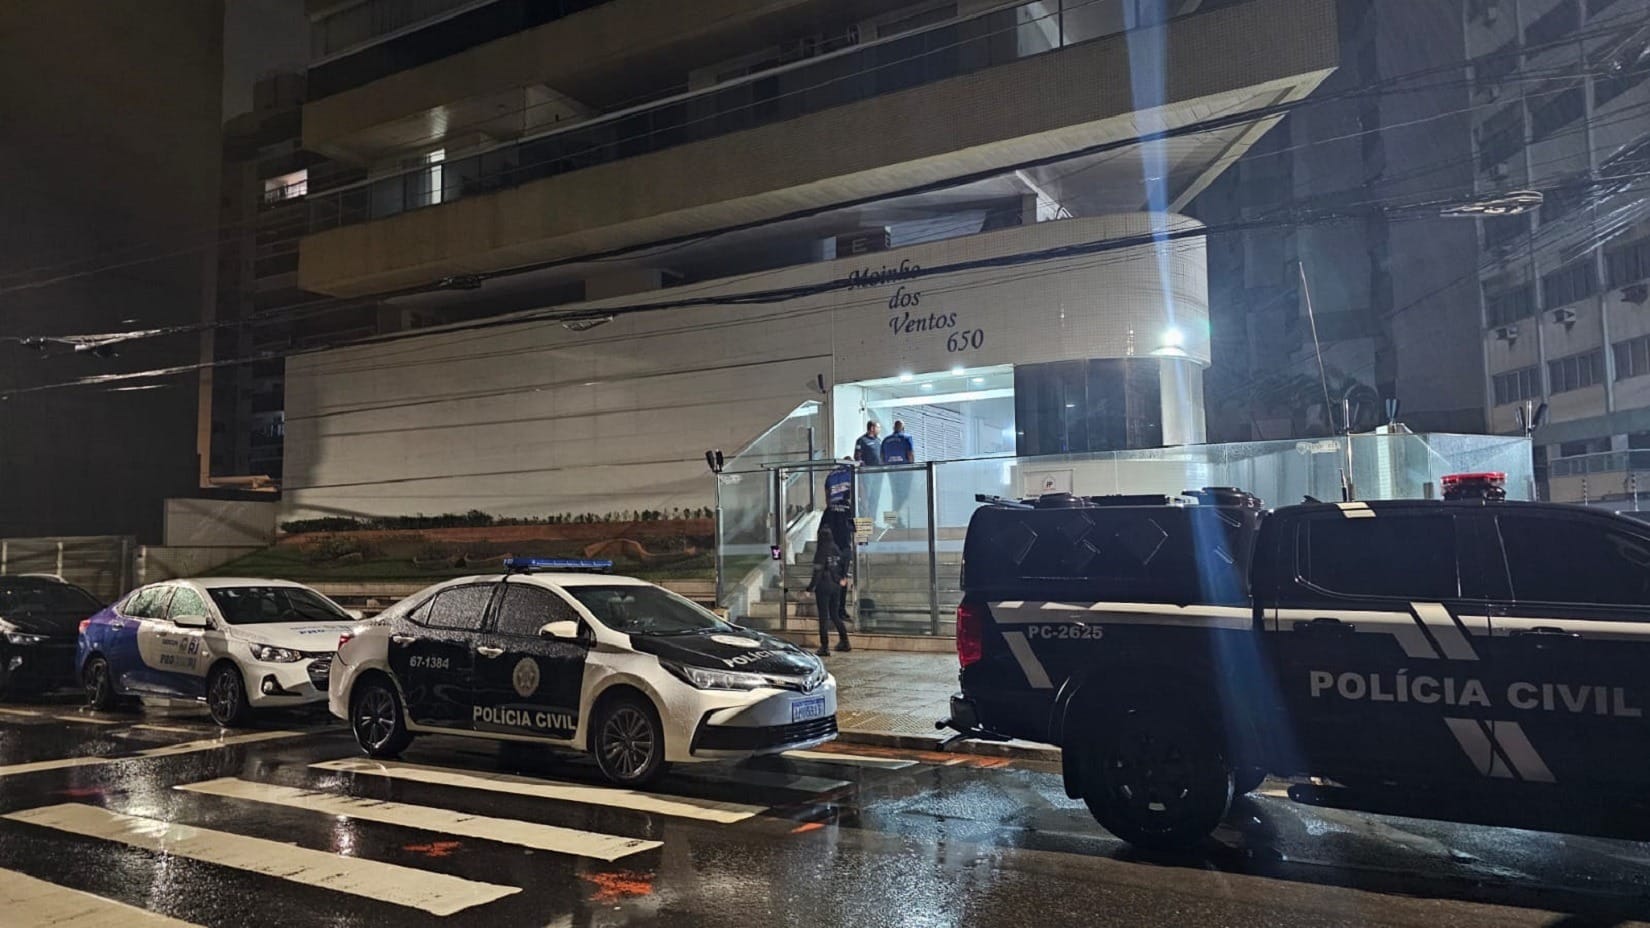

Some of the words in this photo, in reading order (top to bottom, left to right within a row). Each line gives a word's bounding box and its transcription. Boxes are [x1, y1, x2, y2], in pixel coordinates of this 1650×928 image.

[848, 259, 921, 290] Moinho
[889, 286, 921, 309] dos
[889, 312, 957, 335] Ventos
[947, 329, 984, 352] 650
[1028, 625, 1104, 640] PC-2625
[409, 656, 450, 669] 67-1384
[1309, 668, 1492, 707] POLÍCIA
[1506, 682, 1642, 717] CIVIL
[535, 711, 576, 731] CIVIL
